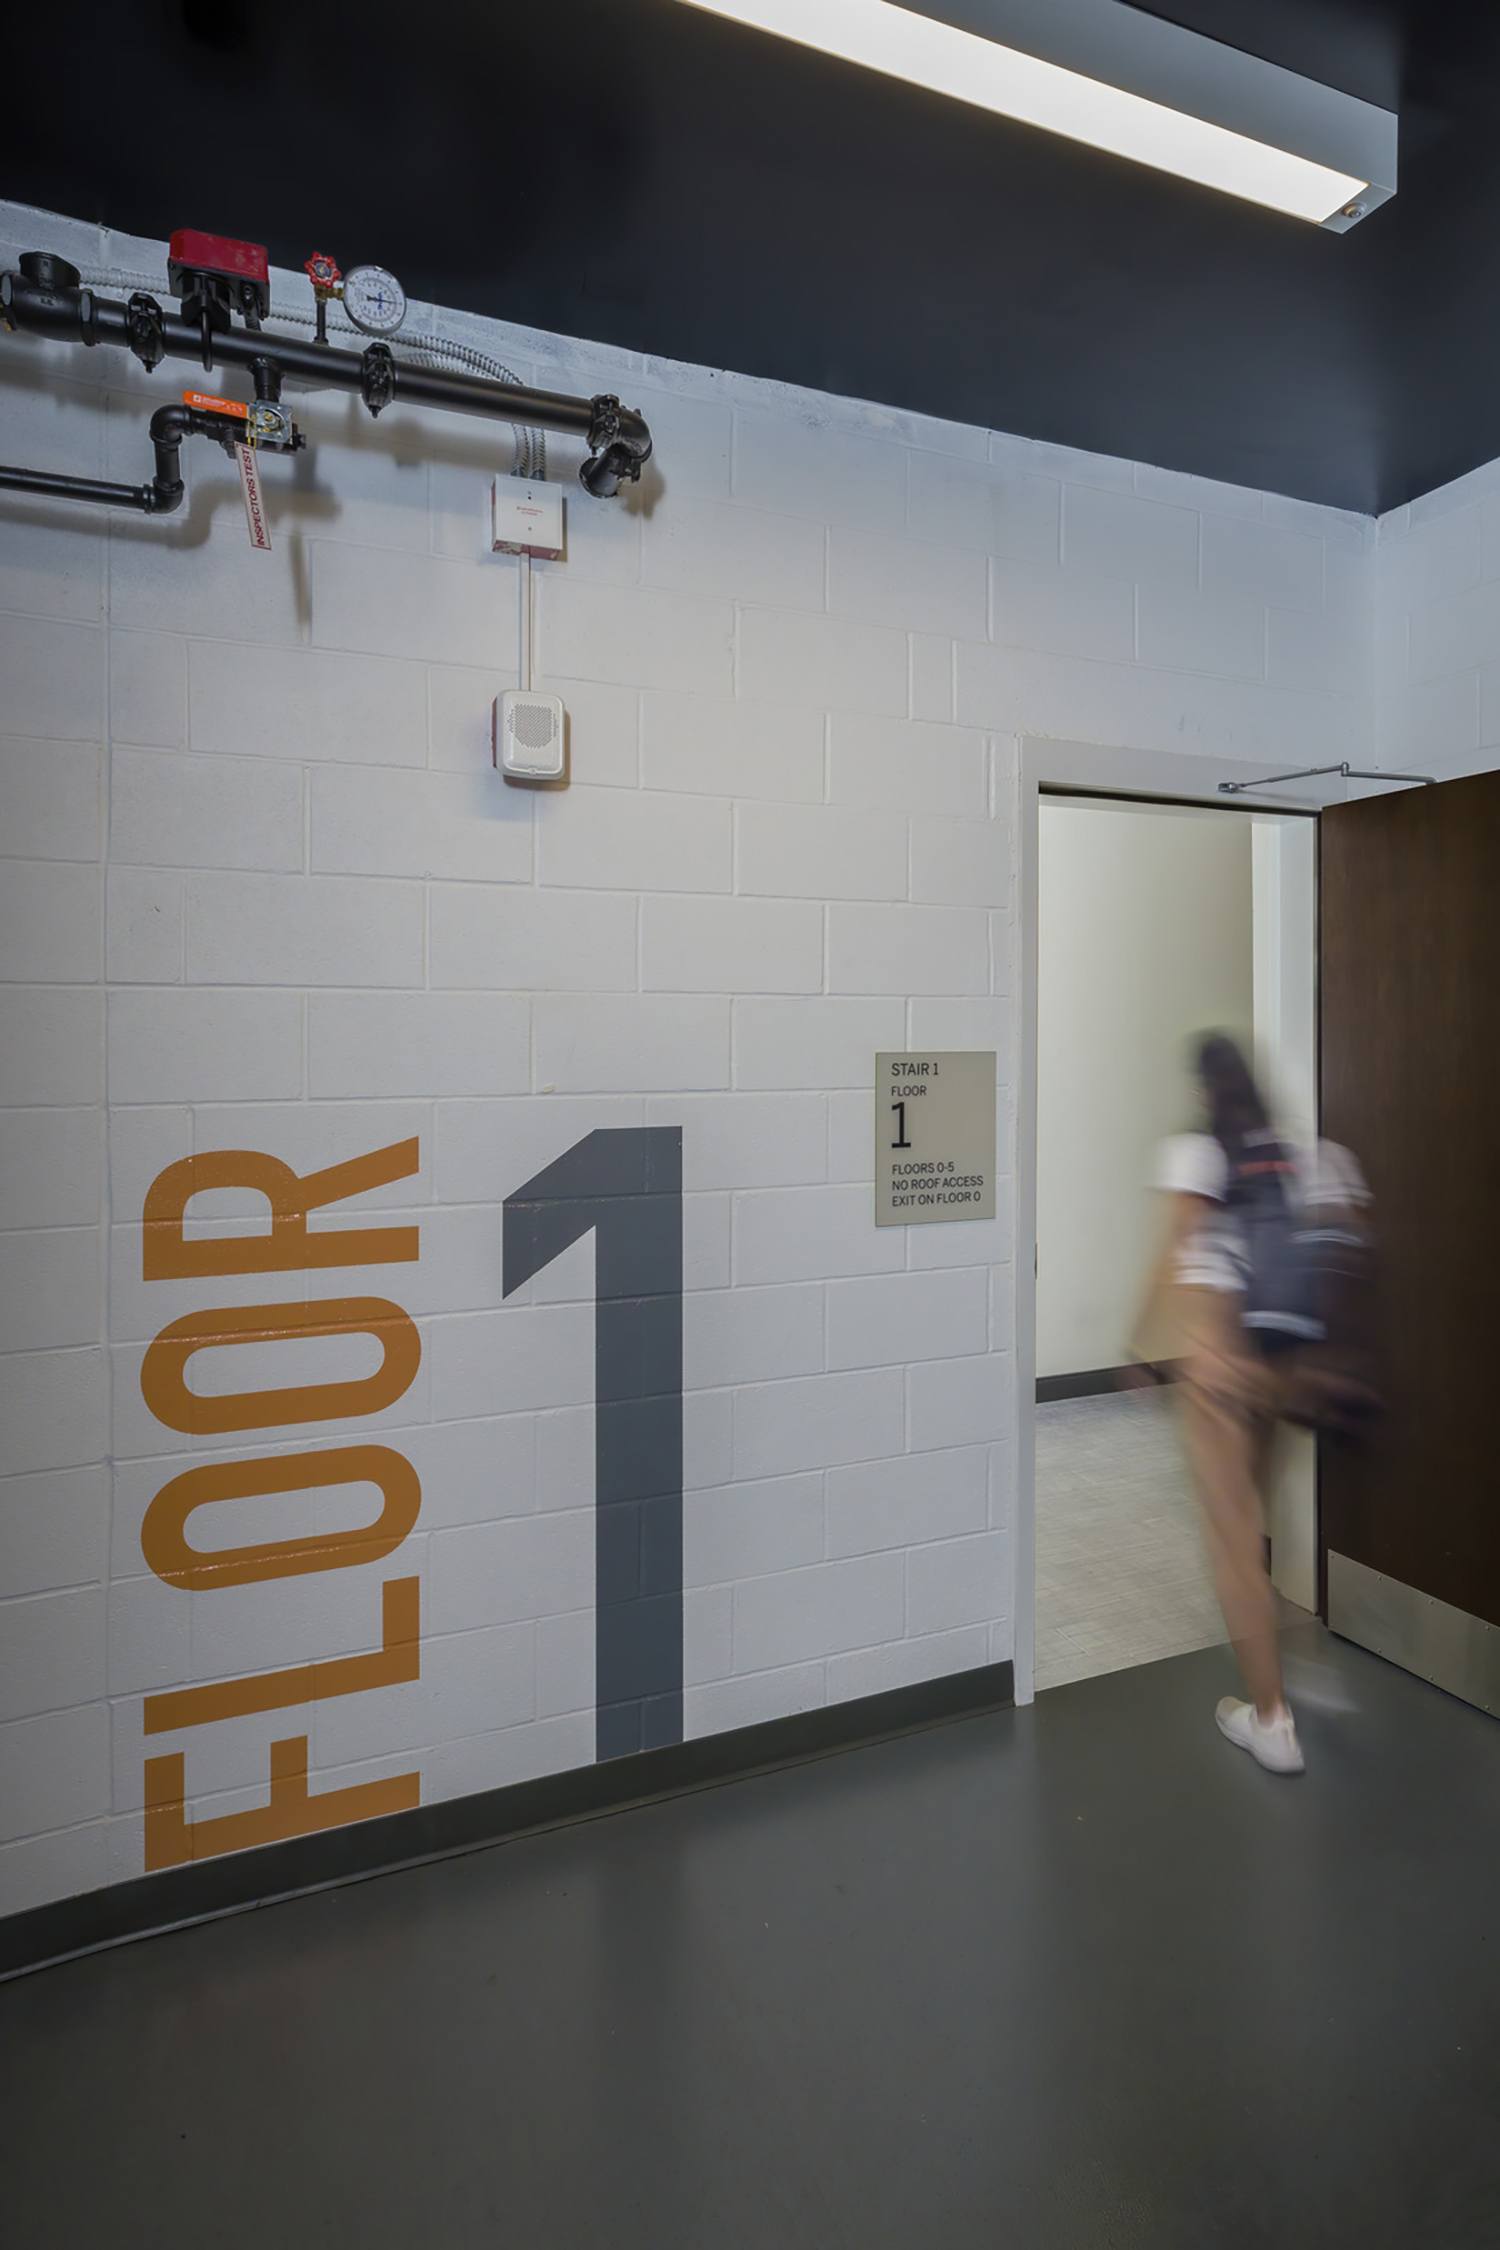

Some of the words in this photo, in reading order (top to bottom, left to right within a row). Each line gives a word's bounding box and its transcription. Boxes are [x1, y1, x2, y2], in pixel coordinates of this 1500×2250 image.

[242, 447, 254, 477] TEST
[891, 1062, 930, 1076] STAIR
[933, 1062, 939, 1076] 1
[891, 1085, 928, 1097] FLOOR
[891, 1101, 912, 1149] 1
[892, 1162, 935, 1175] FLOORS
[937, 1161, 955, 1173] 0-5
[892, 1179, 909, 1191] NO
[911, 1177, 942, 1190] ROOF
[942, 1175, 984, 1188] ACCESS
[892, 1195, 916, 1207] EXIT
[918, 1193, 935, 1205] ON
[936, 1192, 972, 1204] FLOOR
[973, 1191, 981, 1201] 0
[502, 1125, 684, 1763] 1
[140, 1135, 422, 1873] FLOOR
